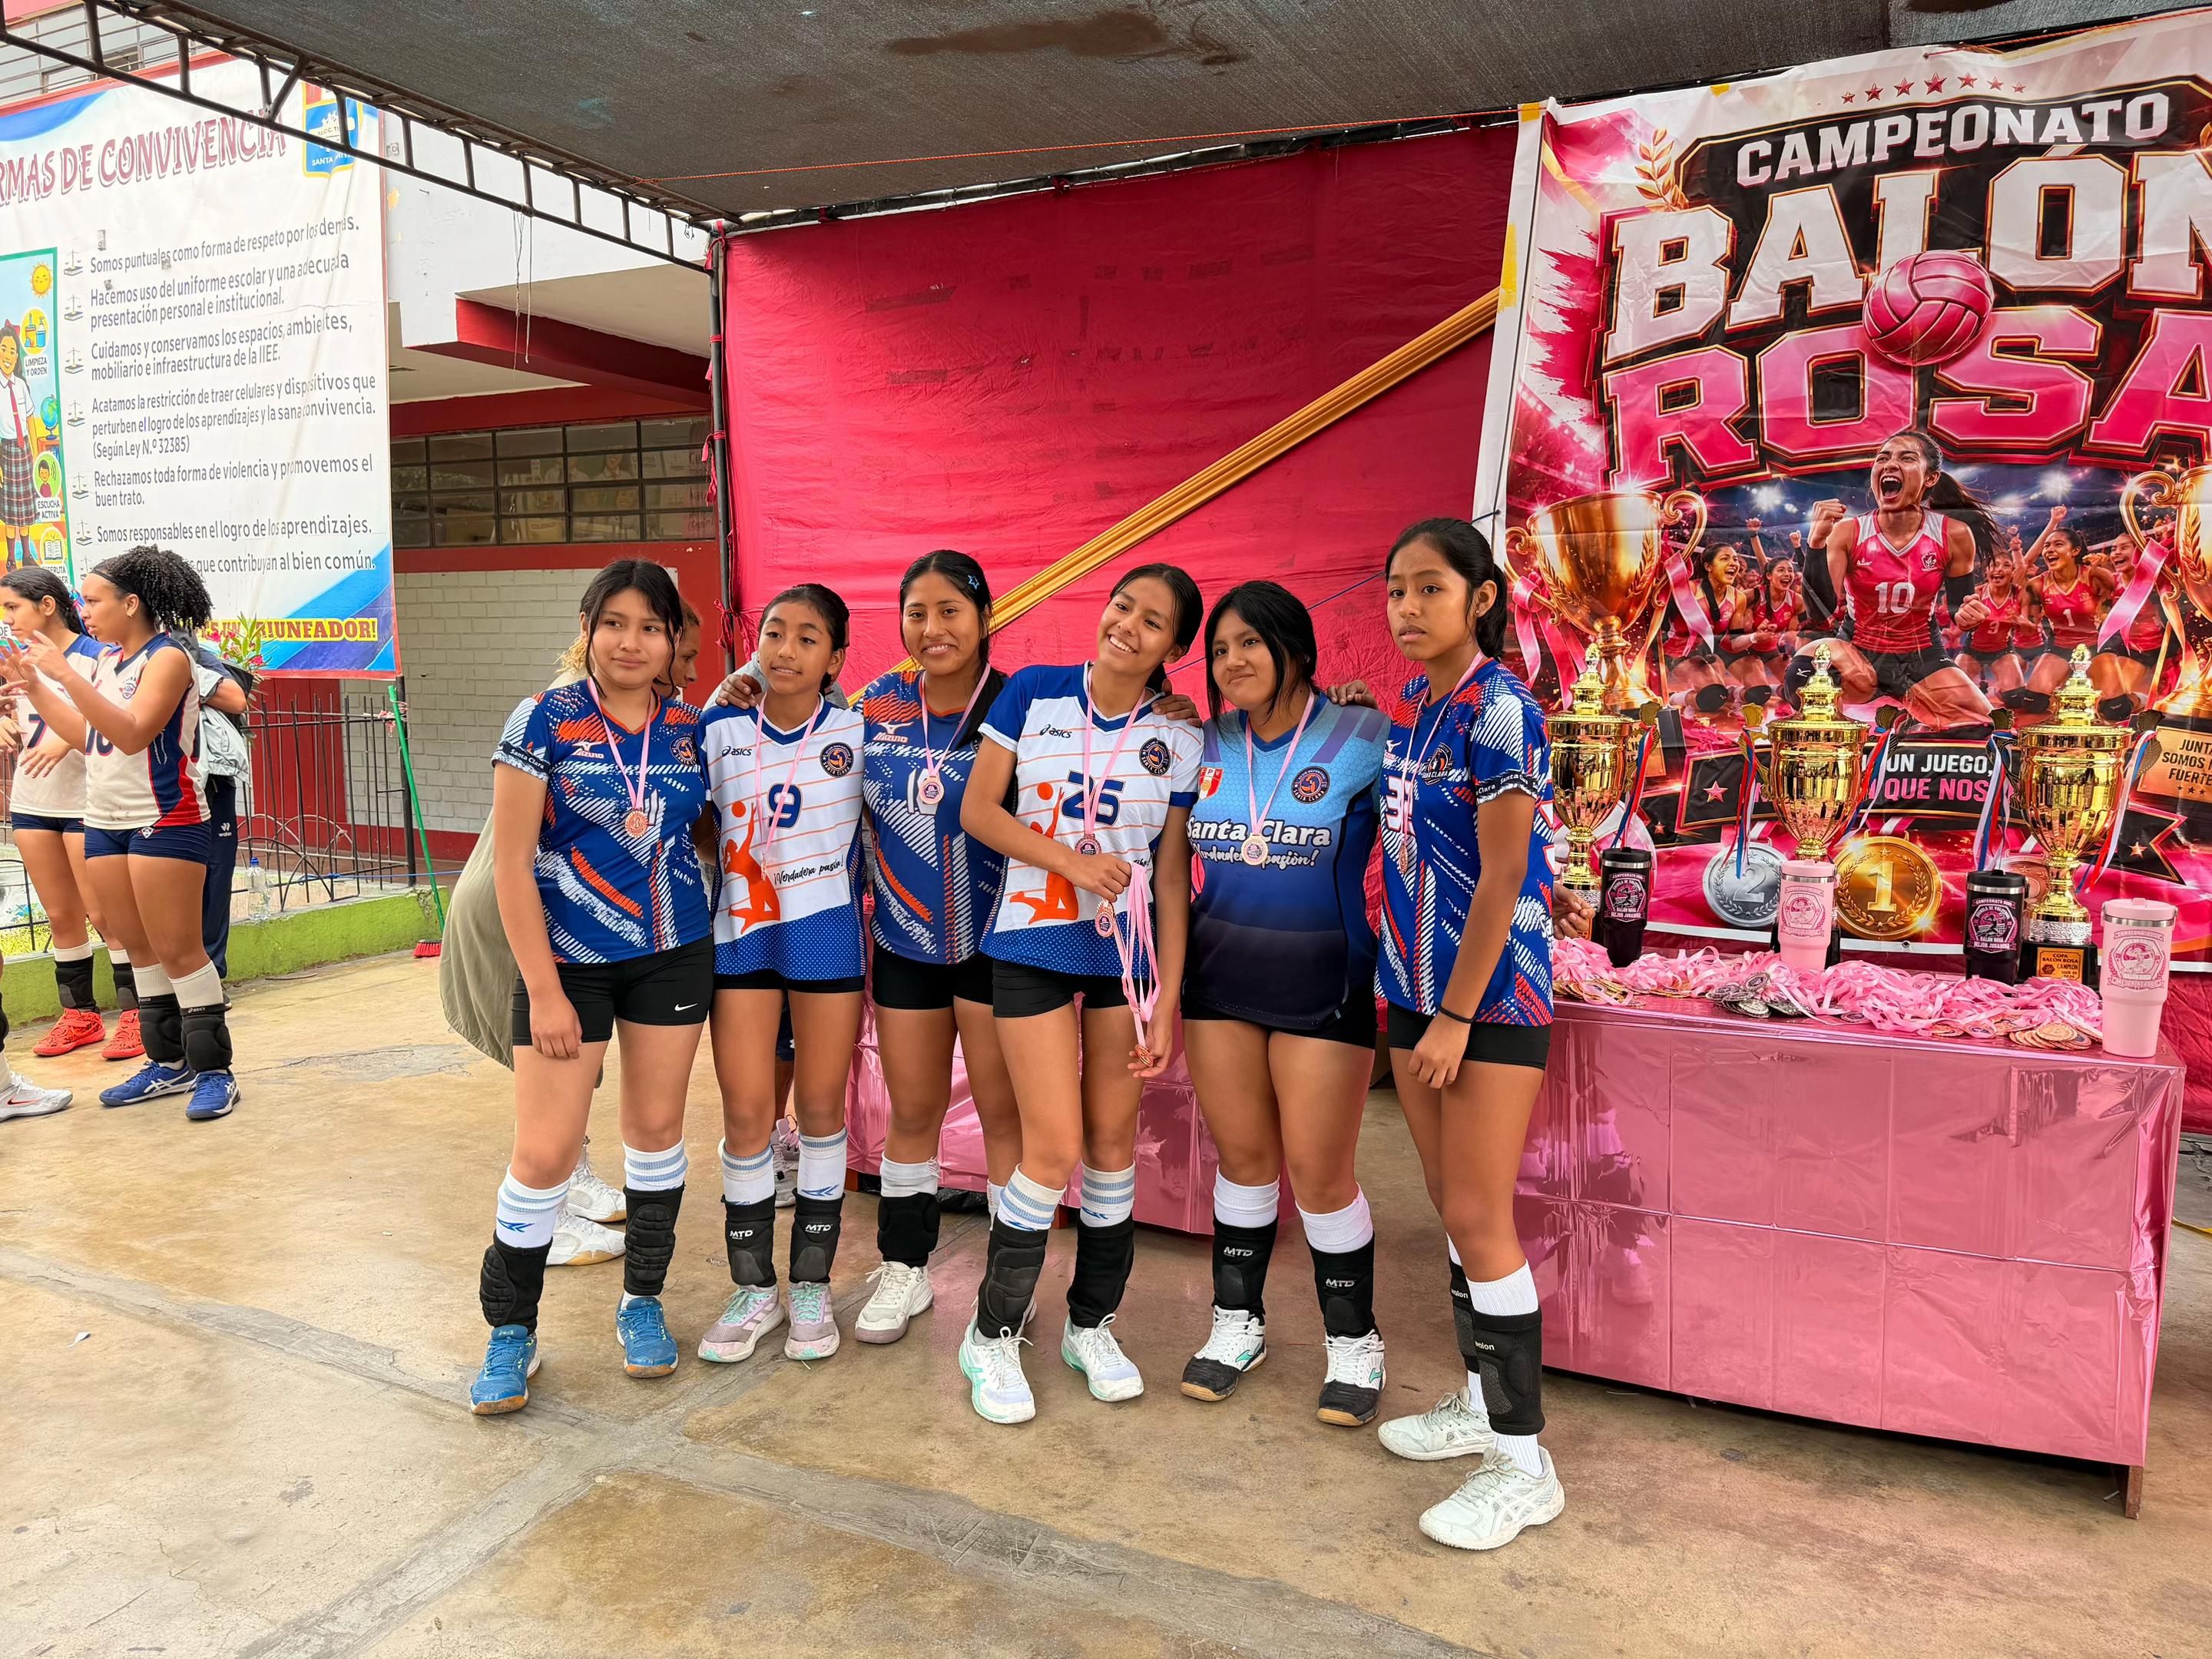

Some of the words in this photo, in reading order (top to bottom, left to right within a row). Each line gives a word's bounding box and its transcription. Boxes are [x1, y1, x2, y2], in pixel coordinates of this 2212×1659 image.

[60, 144, 93, 195] DE
[98, 108, 286, 188] CONVIVENCIA
[1737, 91, 2171, 187] CAMPEONATO
[312, 157, 333, 166] SANTA
[91, 257, 123, 273] Somos
[124, 248, 171, 273] puntuales
[173, 246, 199, 262] como
[201, 240, 231, 258] forma
[233, 235, 246, 253] de
[247, 230, 284, 252] respeto
[286, 228, 304, 247] por
[306, 223, 318, 240] los
[91, 287, 137, 307] Hacemos
[140, 286, 157, 301] uso
[160, 279, 175, 298] del
[177, 275, 226, 296] uniforme
[228, 267, 266, 289] escolar
[268, 269, 274, 286] y
[276, 265, 296, 281] una
[91, 303, 157, 332] presentación
[160, 297, 205, 324] personal
[207, 300, 214, 315] e
[216, 286, 284, 314] institucional.
[91, 340, 141, 359] Cuidamos
[144, 341, 149, 358] y
[151, 333, 220, 354] conservamos
[222, 328, 237, 346] los
[239, 320, 286, 346] espacios,
[31, 367, 47, 376] ORDEN
[91, 359, 144, 381] mobiliario
[145, 363, 151, 376] e
[153, 353, 231, 376] infraestructura
[233, 349, 247, 366] de
[248, 346, 257, 364] la
[259, 343, 280, 363] IIEE.
[92, 397, 136, 413] Acatamos
[137, 393, 145, 409] la
[147, 388, 196, 409] restricción
[197, 388, 209, 404] de
[211, 387, 233, 403] traer
[236, 382, 274, 400] celulares
[276, 382, 282, 399] y
[284, 373, 350, 397] dispositivos
[353, 375, 376, 393] que
[1602, 305, 2212, 492] ROSA
[92, 419, 137, 439] perturben
[138, 416, 146, 432] el
[147, 416, 171, 435] logro
[173, 414, 184, 429] de
[186, 412, 200, 429] los
[201, 407, 259, 430] aprendizajes
[260, 408, 266, 425] y
[267, 405, 276, 421] la
[278, 405, 302, 419] sana
[302, 396, 376, 417] convivencia.
[93, 440, 124, 461] (Según
[125, 440, 141, 459] Ley
[158, 435, 190, 453] 32385)
[94, 469, 152, 488] Rechazamos
[154, 466, 175, 484] toda
[177, 465, 207, 482] forma
[209, 463, 221, 480] de
[224, 459, 269, 479] violencia
[271, 462, 278, 480] y
[280, 458, 358, 479] promovemos
[362, 453, 373, 472] el
[38, 500, 60, 508] ESCUCHA
[95, 491, 118, 507] buen
[119, 489, 145, 505] trato.
[97, 525, 127, 542] Somos
[129, 522, 193, 544] responsables
[195, 526, 207, 539] en
[209, 520, 217, 538] el
[220, 520, 250, 541] logro
[253, 519, 267, 537] de
[268, 518, 280, 536] los
[280, 514, 372, 539] aprendizajes.
[196, 559, 215, 575] que
[217, 553, 277, 575] contribuyan
[280, 551, 290, 571] al
[293, 551, 321, 570] bien
[326, 549, 376, 570] común.
[1875, 581, 1916, 614] 10
[256, 620, 376, 639] RIUNFADOR!
[2063, 608, 2075, 627] 1
[27, 714, 48, 750] 7
[2179, 739, 2212, 755] JUNT
[510, 748, 528, 760] Santa
[528, 757, 545, 770] Clara
[730, 748, 752, 757] asics
[1886, 753, 1915, 772] UN
[1920, 754, 1993, 777] JUEGO,
[2161, 751, 2205, 769] SOMOS
[1479, 784, 1495, 794] Clara
[1500, 773, 1518, 784] Santa
[1884, 777, 1931, 802] QUE
[1939, 777, 1990, 803] NOS
[768, 783, 802, 829] 9
[1187, 816, 1247, 841] Santa
[1261, 820, 1332, 846] Clara
[1733, 863, 1765, 902] 2
[1867, 860, 1896, 912] 1
[1224, 1247, 1253, 1257] MTD
[1326, 1278, 1355, 1287] MTD
